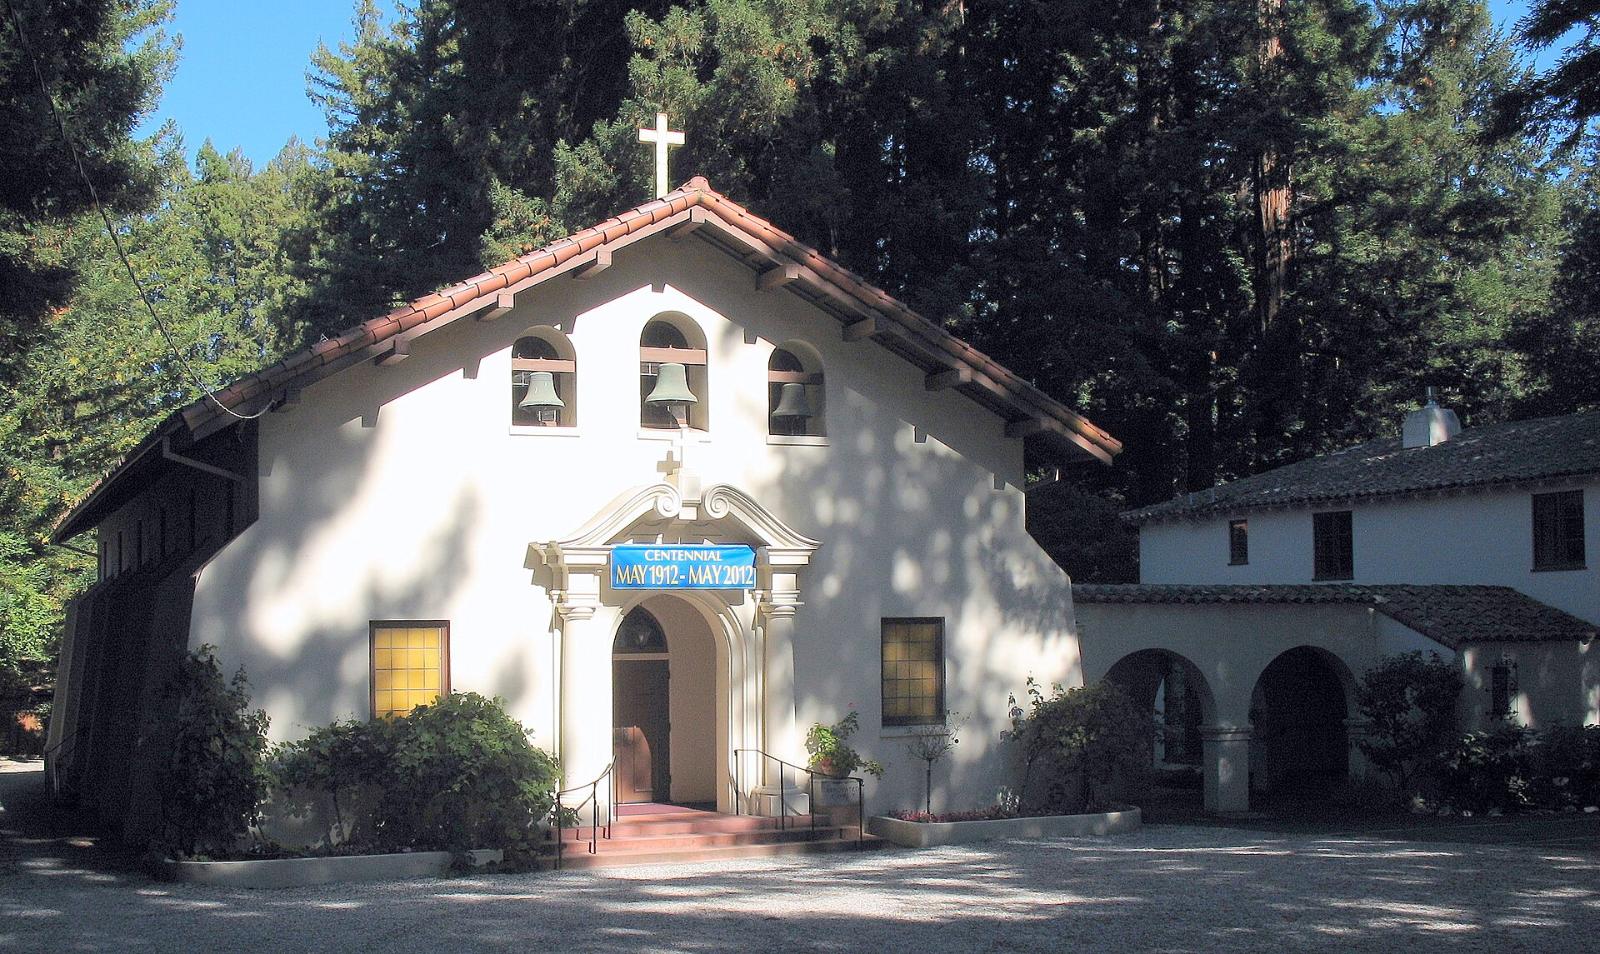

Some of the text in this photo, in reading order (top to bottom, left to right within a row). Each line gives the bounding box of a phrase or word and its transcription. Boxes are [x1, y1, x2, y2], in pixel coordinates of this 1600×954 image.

[644, 549, 723, 562] CENTENNIAL
[616, 565, 648, 584] MAY
[688, 565, 722, 585] MAY
[723, 565, 753, 584] 2012
